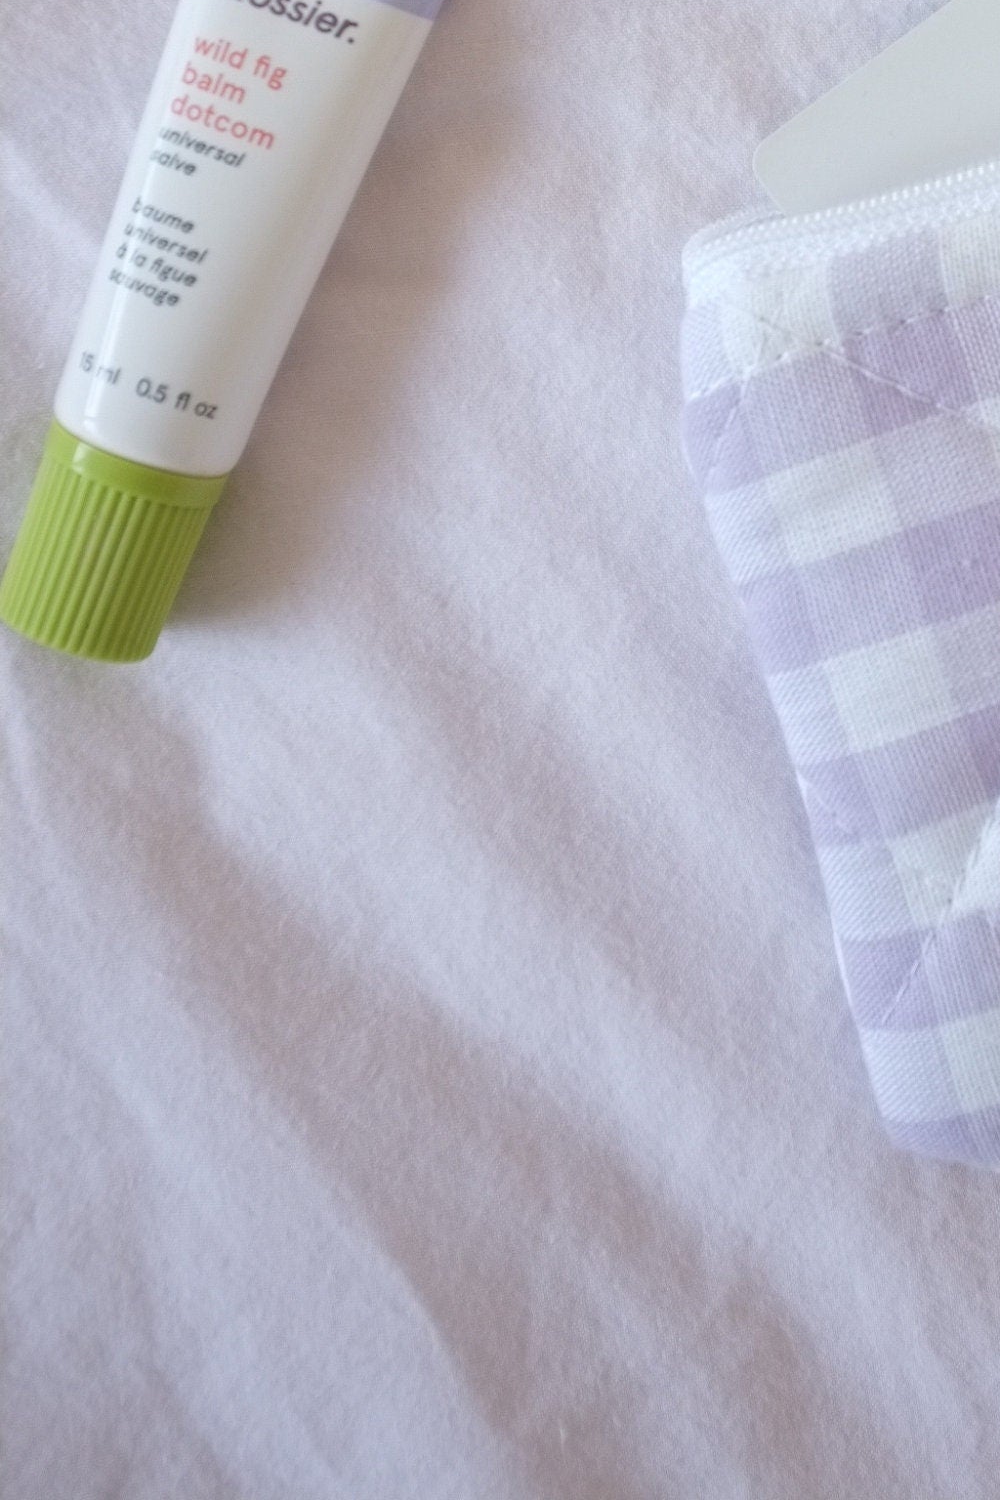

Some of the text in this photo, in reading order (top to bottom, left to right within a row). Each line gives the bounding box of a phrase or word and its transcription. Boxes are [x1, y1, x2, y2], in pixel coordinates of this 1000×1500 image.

[181, 62, 246, 104] balm
[194, 36, 287, 91] wild fig
[170, 95, 275, 150] dotcom
[149, 149, 197, 176] salve
[159, 126, 247, 168] universal
[150, 256, 198, 288] figue
[135, 376, 169, 404] 0.5
[174, 390, 193, 411] fl
[193, 400, 219, 420] oz
